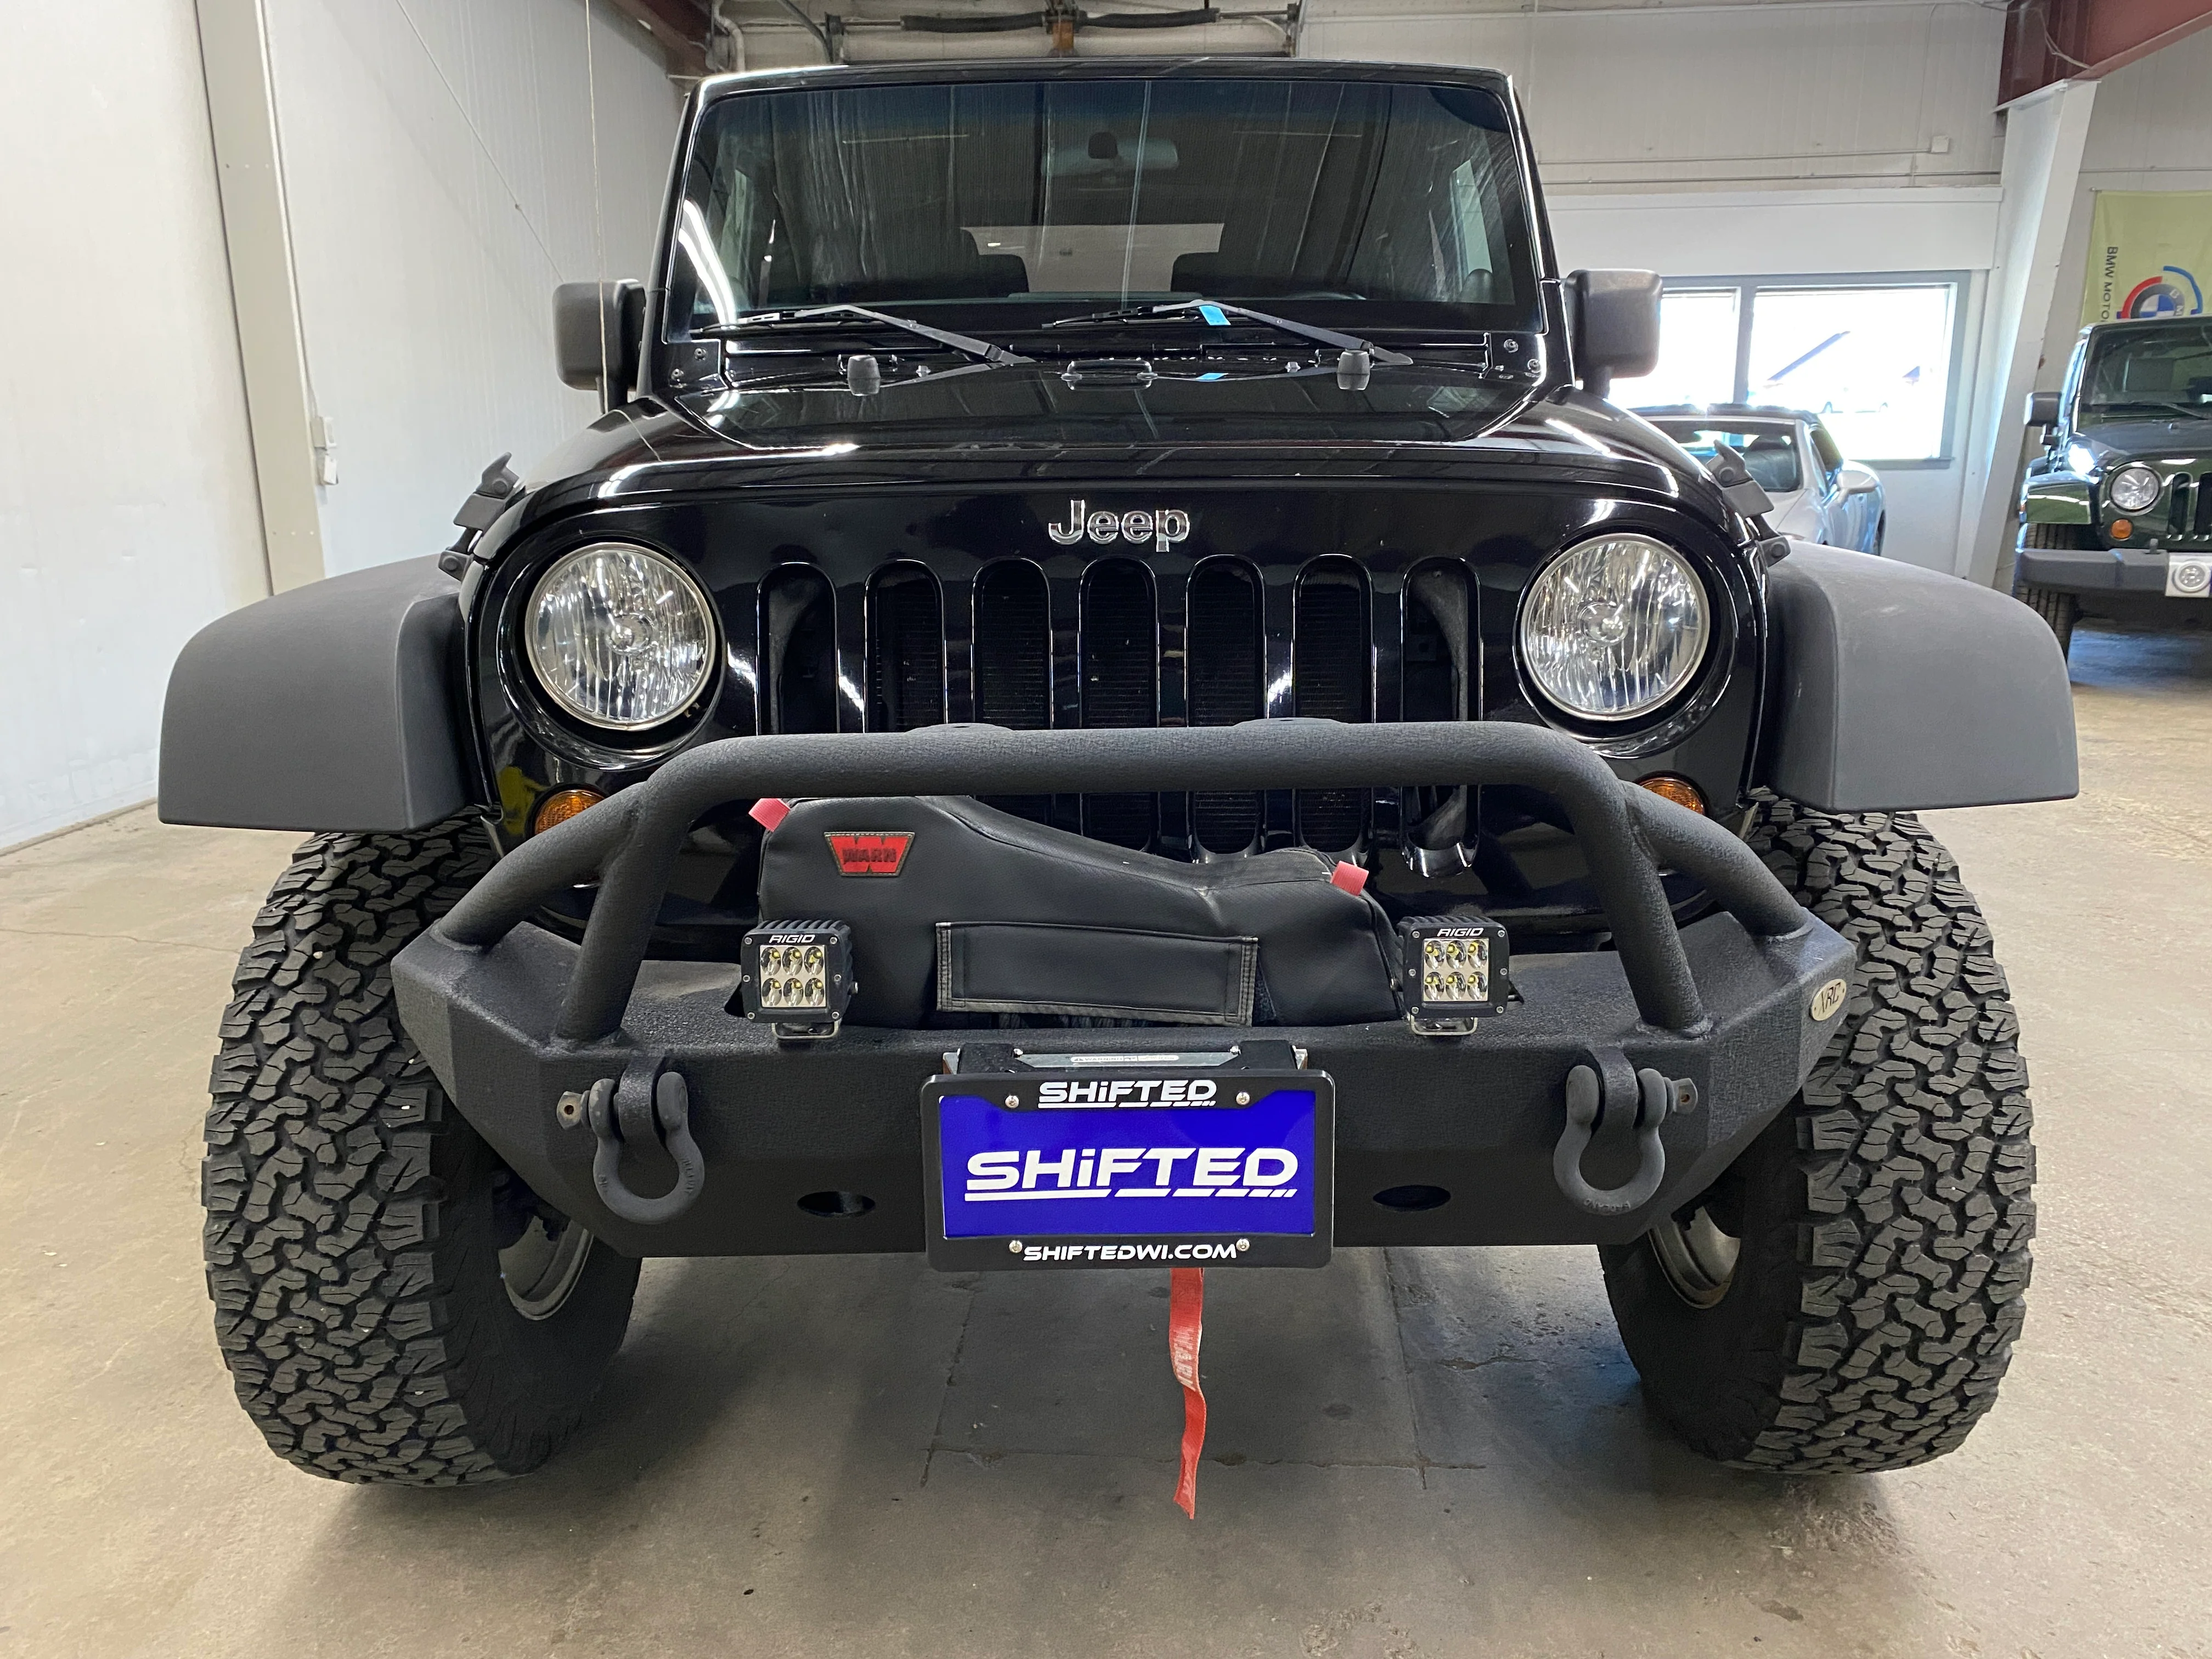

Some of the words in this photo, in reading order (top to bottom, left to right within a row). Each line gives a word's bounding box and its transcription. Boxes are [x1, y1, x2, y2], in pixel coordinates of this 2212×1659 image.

[2105, 246, 2118, 278] BMW
[2101, 282, 2113, 322] MOTO
[1048, 499, 1190, 552] Jeep
[842, 848, 896, 865] WARN
[769, 934, 816, 944] RIGID
[1437, 928, 1484, 937] RIGID
[1023, 1244, 1238, 1262] SHIFTEDWI.COM
